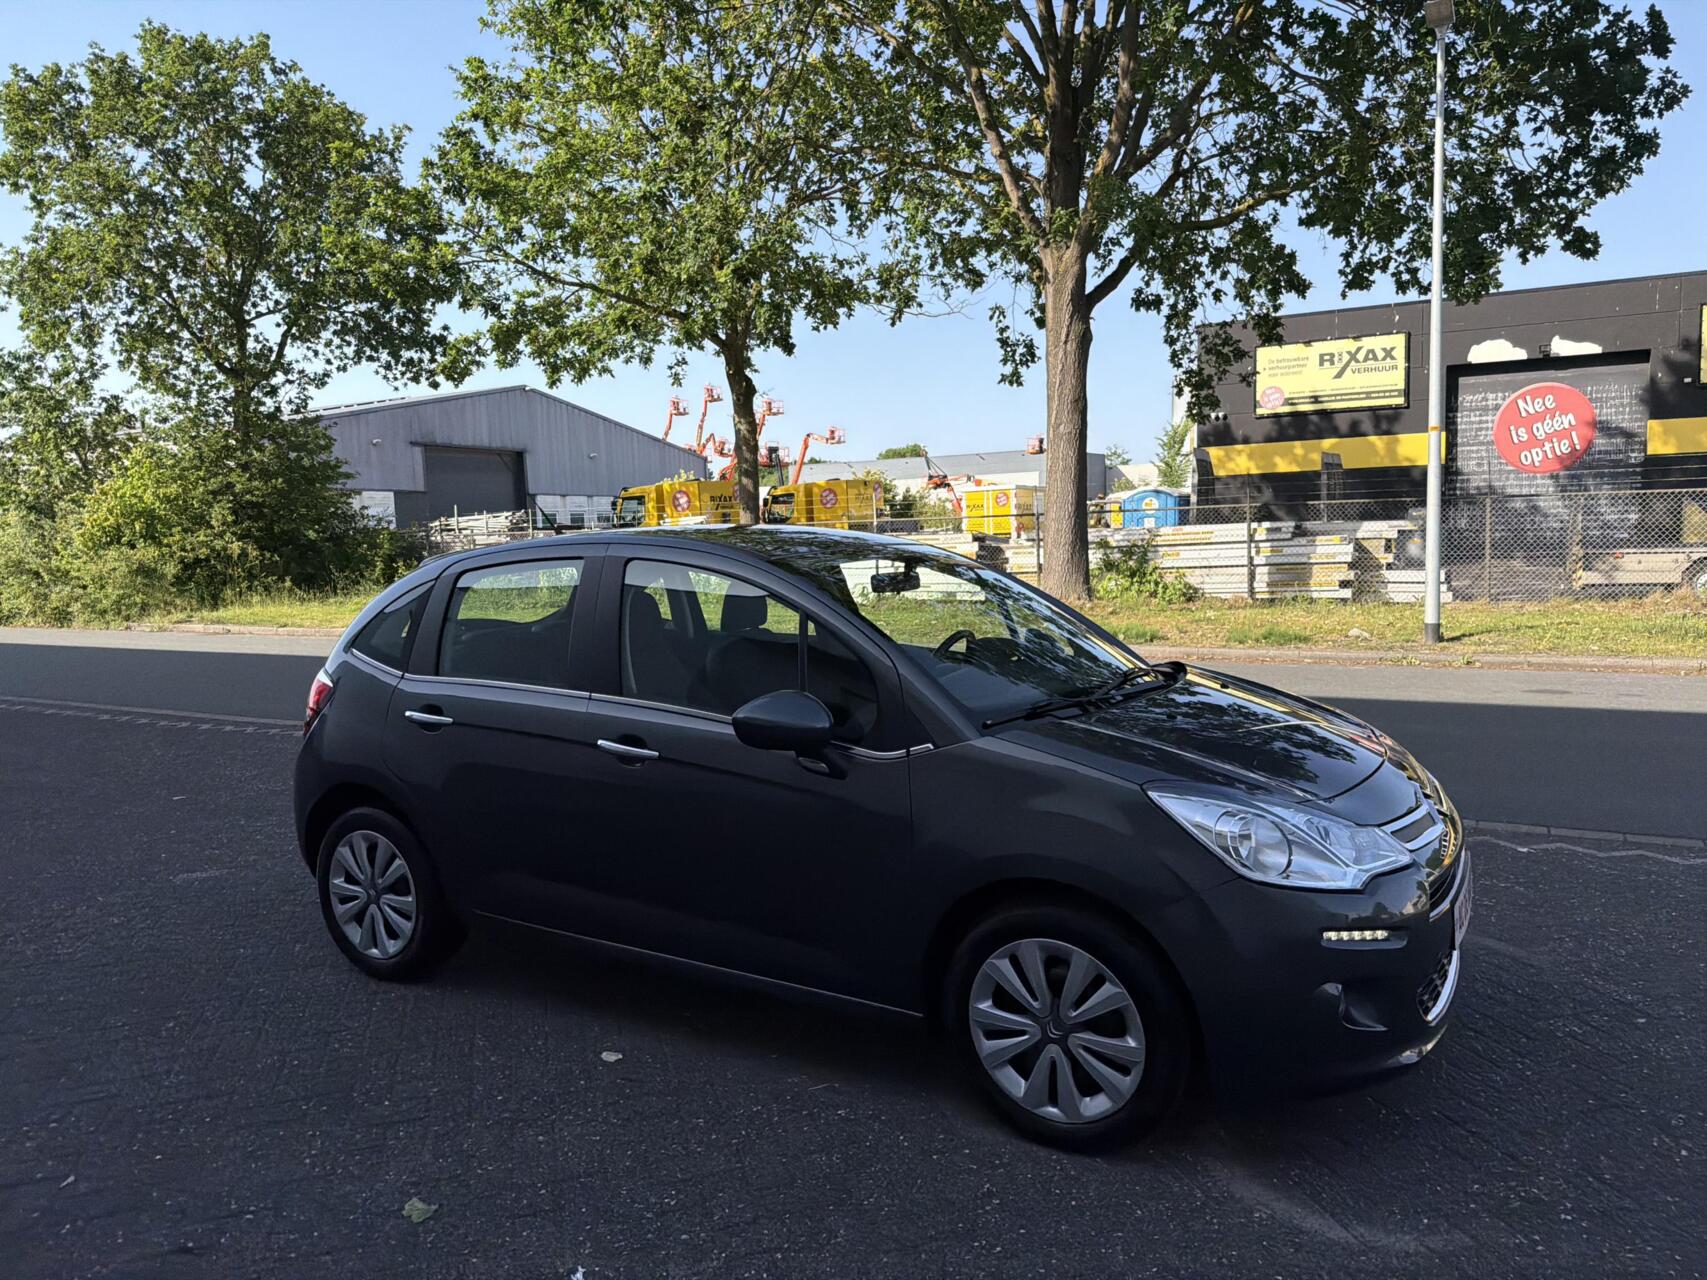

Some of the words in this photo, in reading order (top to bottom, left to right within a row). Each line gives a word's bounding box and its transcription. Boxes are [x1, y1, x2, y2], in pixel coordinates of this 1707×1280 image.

[1351, 364, 1398, 374] VERHUUR
[1516, 394, 1556, 417] Nee
[1509, 425, 1528, 444] is
[1532, 411, 1576, 440] géén
